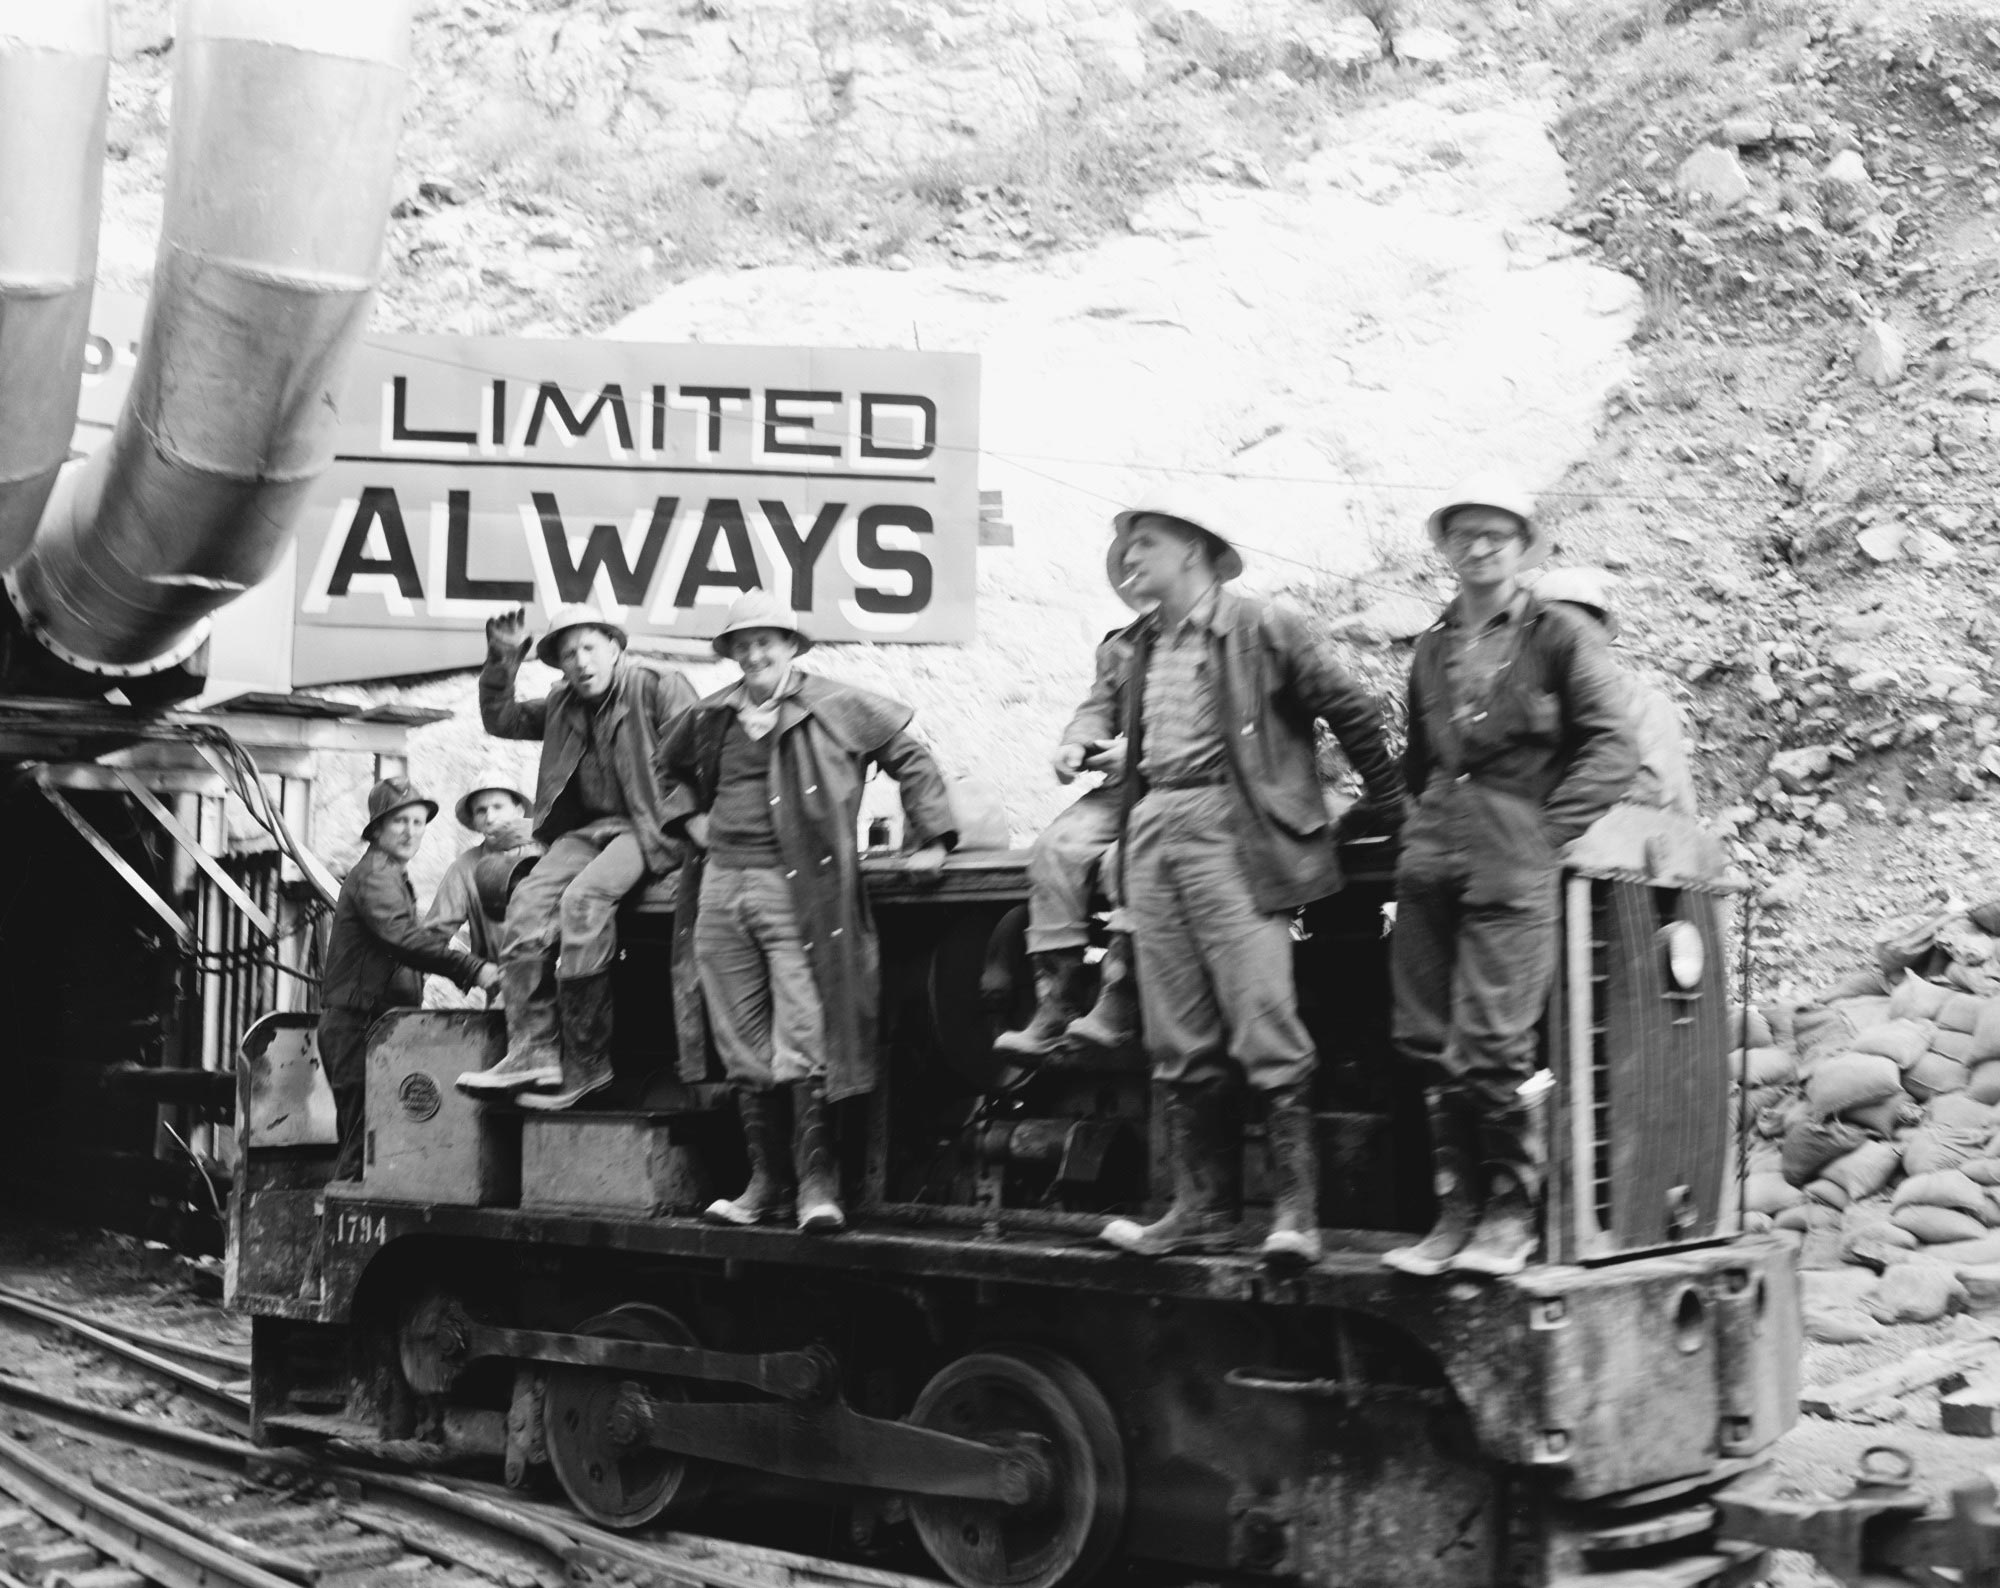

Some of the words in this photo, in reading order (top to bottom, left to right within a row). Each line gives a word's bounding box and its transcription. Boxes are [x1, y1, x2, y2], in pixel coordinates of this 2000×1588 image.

[391, 376, 937, 462] LIMITED
[325, 486, 934, 615] ALWAYS
[337, 1212, 387, 1246] 1794
